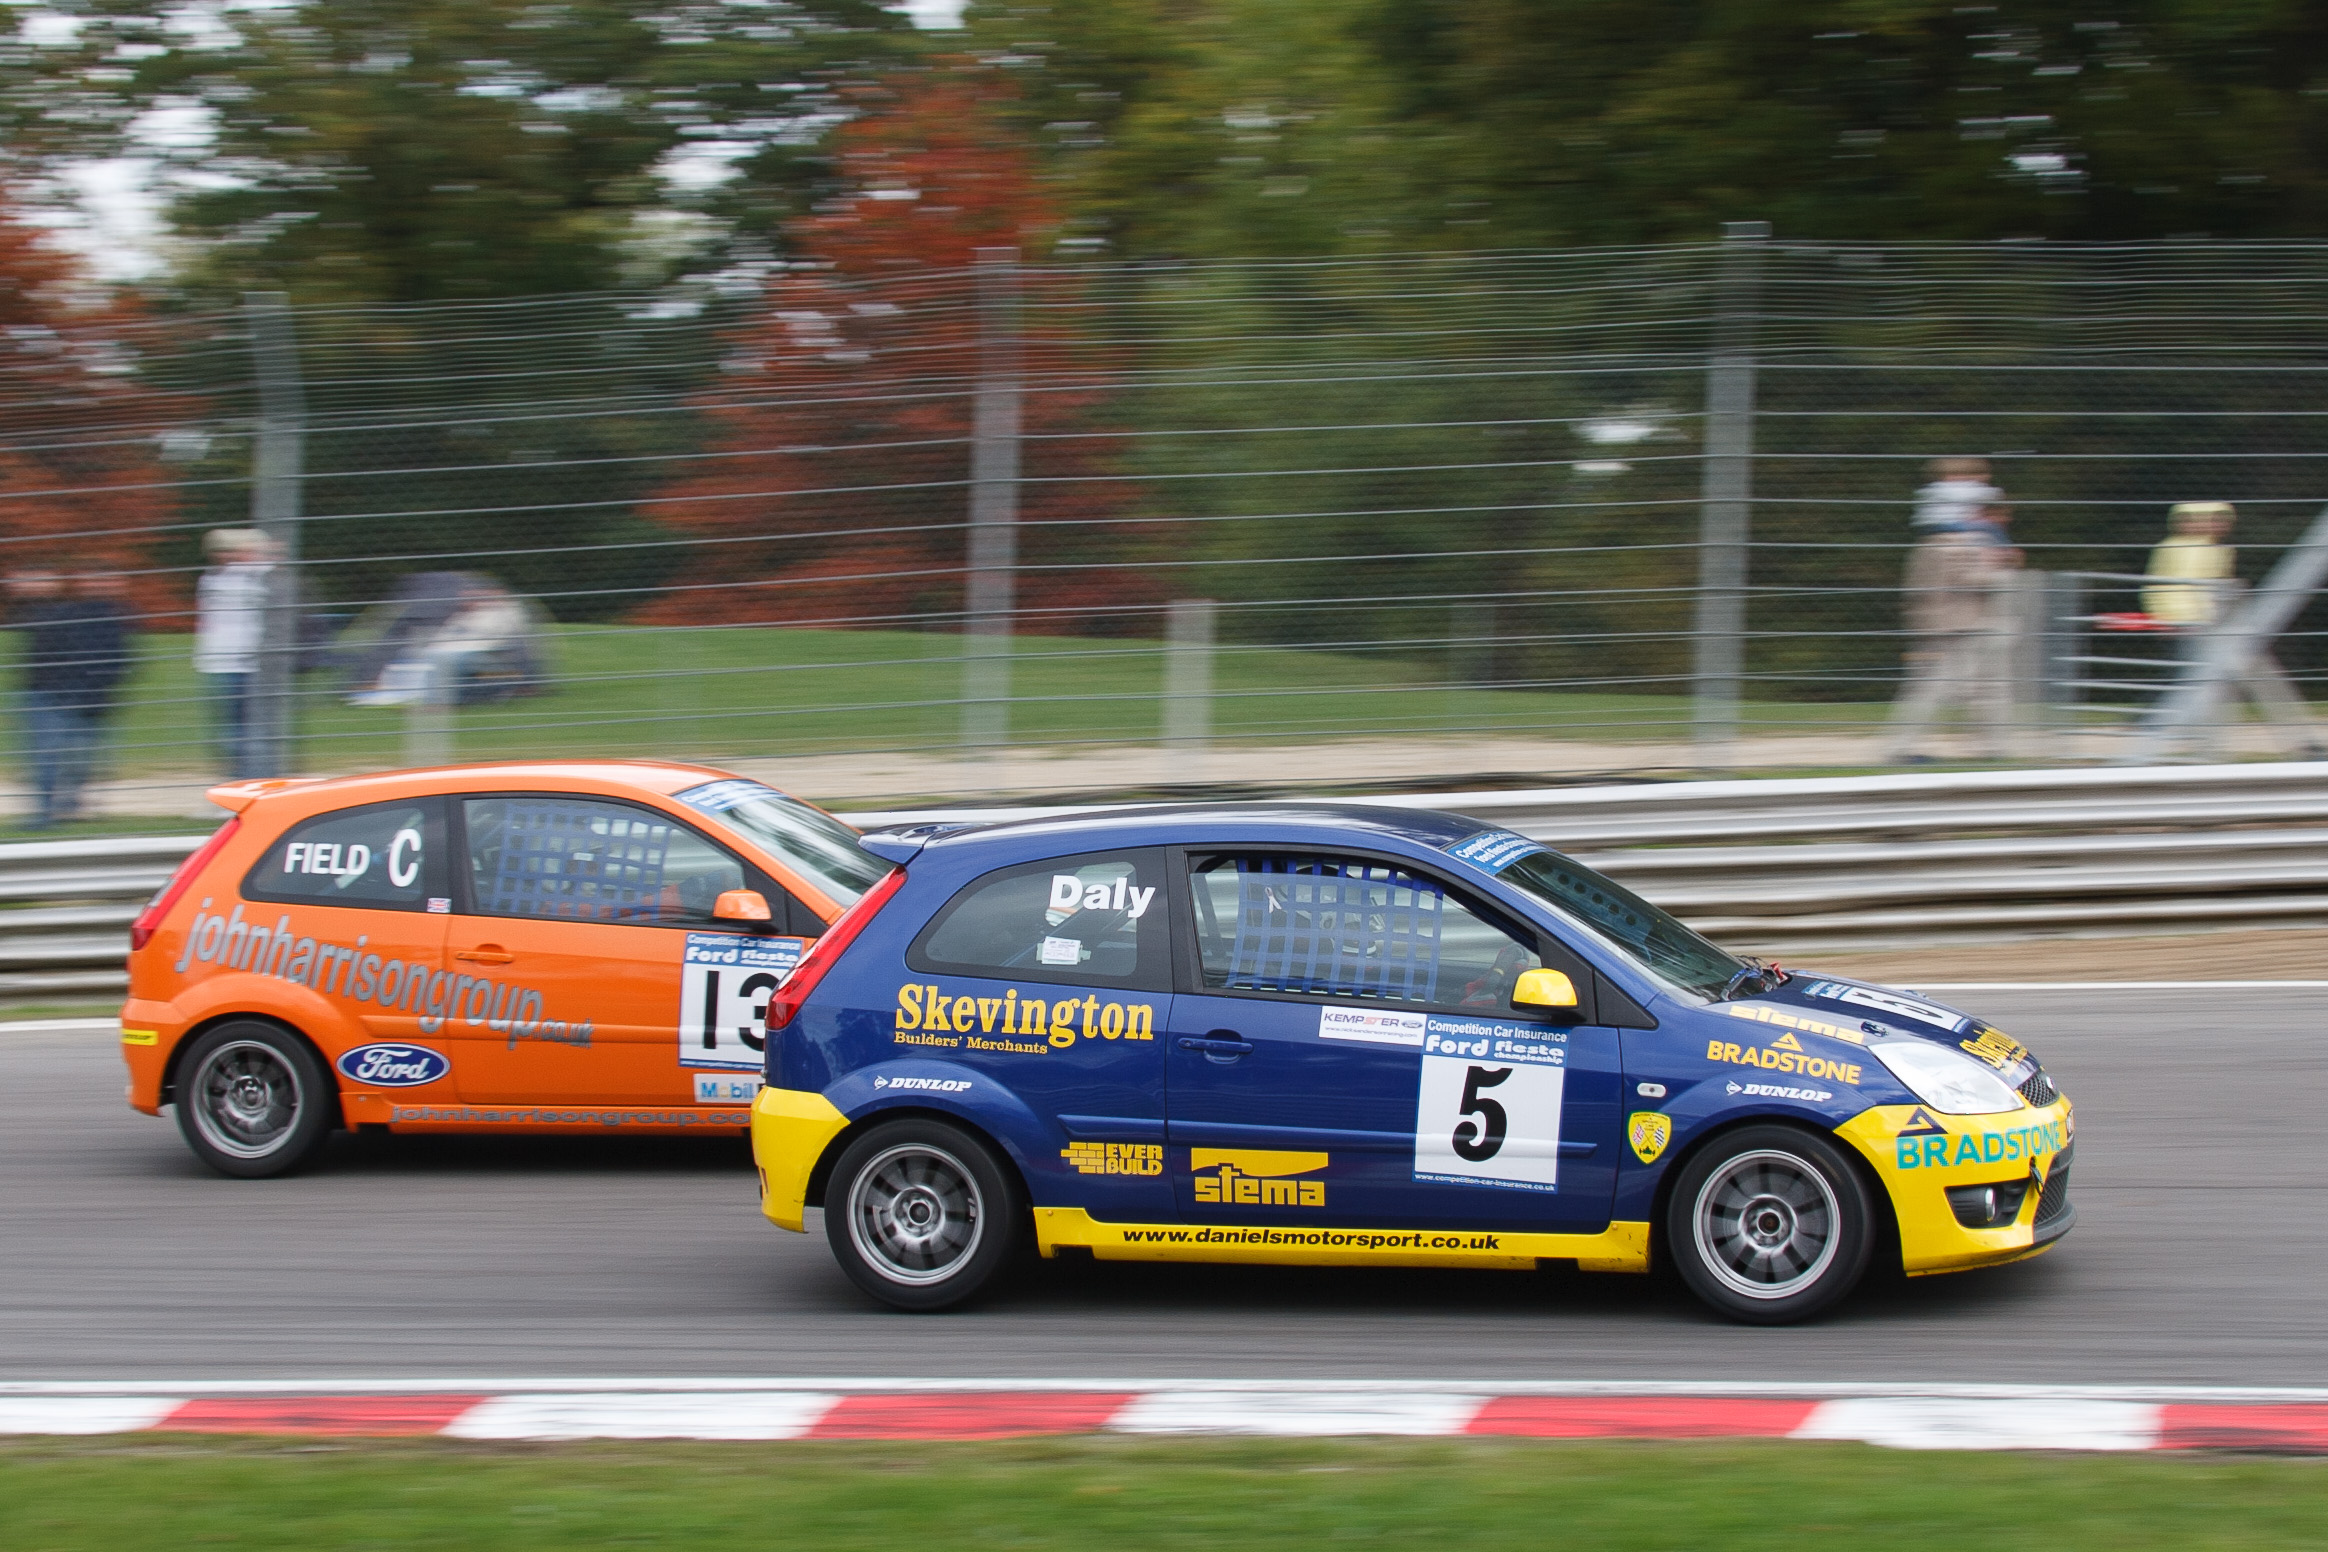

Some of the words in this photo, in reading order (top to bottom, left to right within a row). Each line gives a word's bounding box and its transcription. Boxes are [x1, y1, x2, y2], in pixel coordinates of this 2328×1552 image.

[284, 842, 370, 874] FIELD
[388, 828, 422, 887] C
[1049, 874, 1156, 918] Daly
[703, 970, 783, 1052] 13
[895, 983, 1154, 1048] Skevington
[1324, 1013, 1400, 1027] KEMPSTER
[1729, 1005, 1865, 1044] stema
[1427, 1020, 1492, 1035] Competition
[1494, 1026, 1513, 1037] Car
[1514, 1027, 1567, 1042] Insurance
[966, 1036, 1048, 1054] Merchants
[1494, 1052, 1563, 1064] championship
[357, 1048, 430, 1080] Ford
[1707, 1039, 1862, 1085] BRADSTONE
[701, 1083, 754, 1099] Mobil
[888, 1077, 972, 1092] DUNLOP
[1742, 1083, 1832, 1102] DUNLOP
[1452, 1066, 1513, 1162] 5
[1106, 1143, 1163, 1160] EVER
[1895, 1120, 2063, 1170] BRADSTONE
[1106, 1158, 1163, 1176] BUILD
[1194, 1166, 1326, 1206] stema
[1122, 1228, 1500, 1250] www.danielsmotorsport.co.uk
